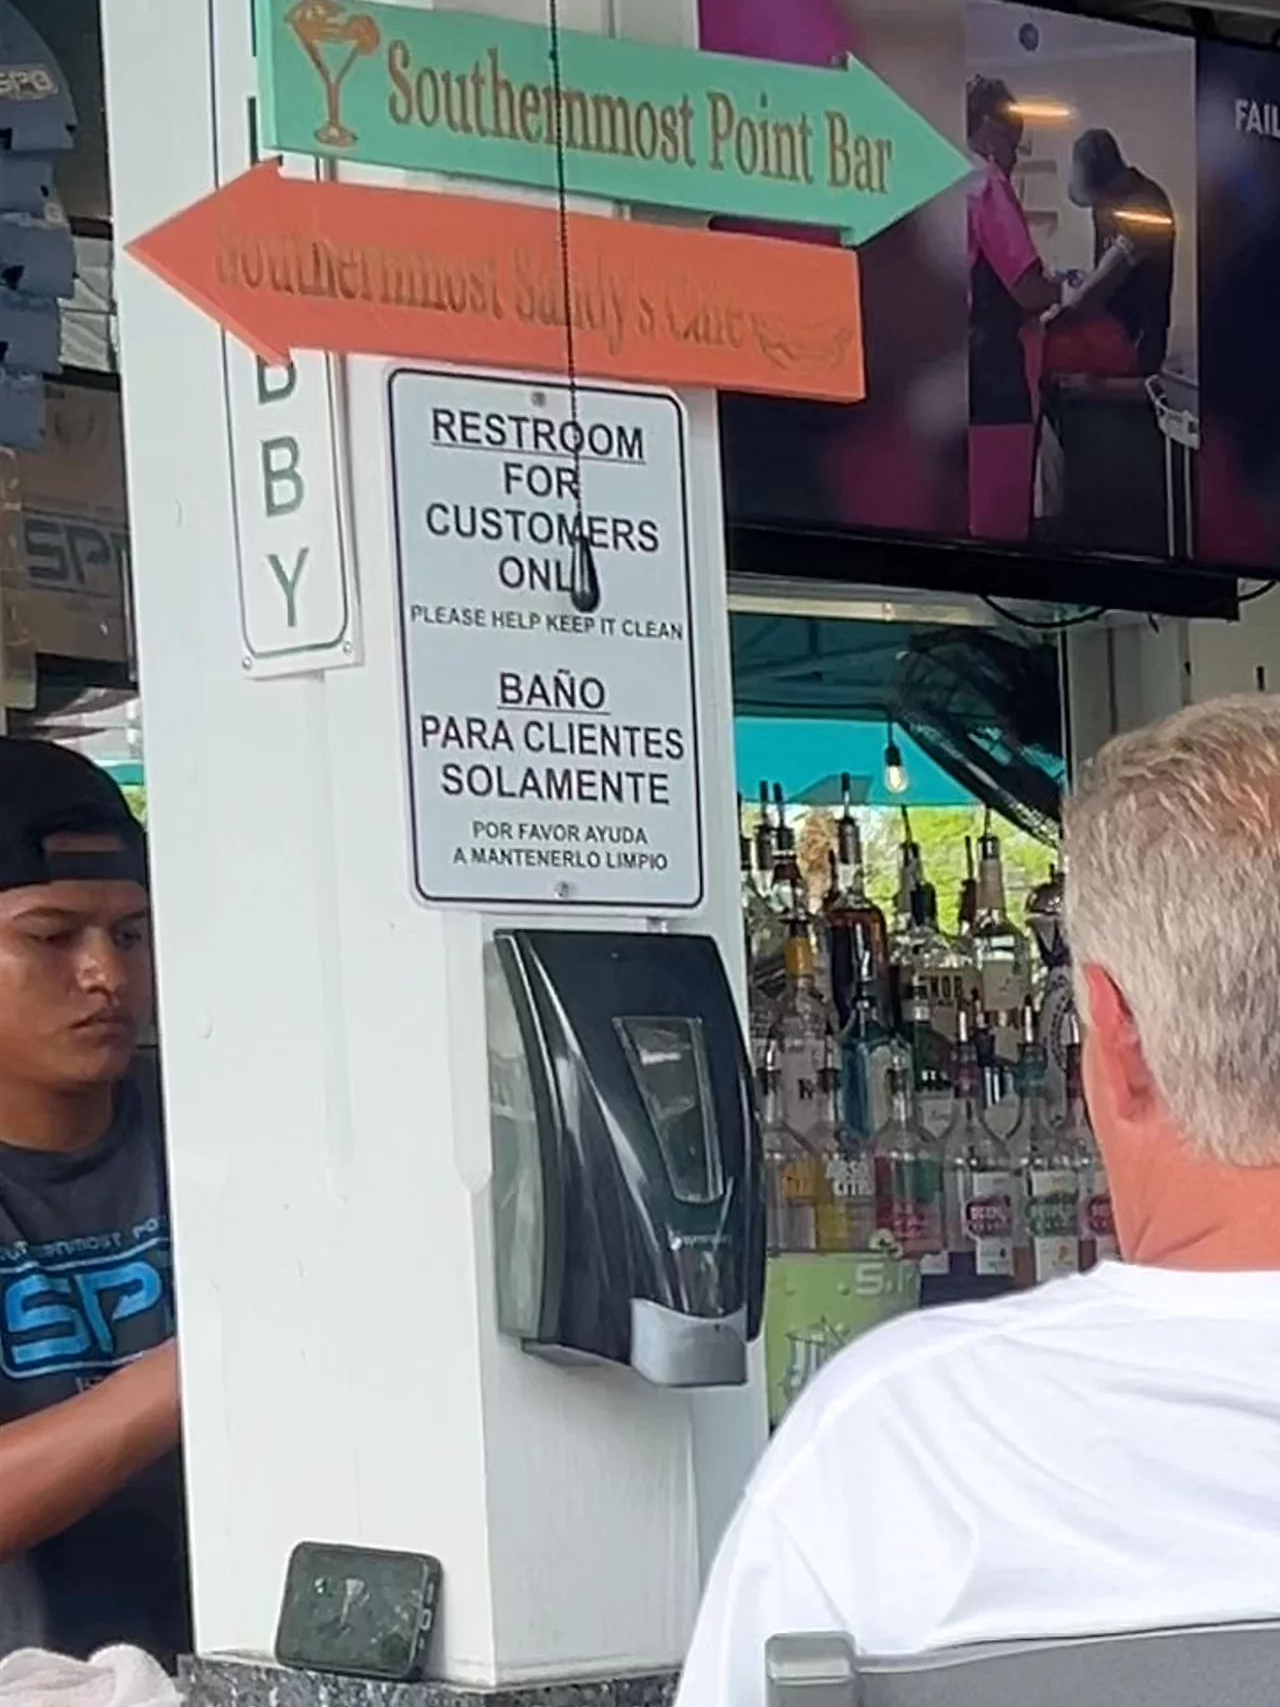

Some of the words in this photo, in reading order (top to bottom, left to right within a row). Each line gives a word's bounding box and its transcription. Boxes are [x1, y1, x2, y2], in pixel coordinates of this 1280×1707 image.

[386, 39, 697, 168] Southernmost
[707, 89, 815, 186] Point
[825, 109, 894, 195] Bar
[215, 198, 504, 319] Southernmost
[513, 247, 656, 355] Sandy's
[431, 407, 645, 460] RESTROOM
[503, 461, 580, 500] FOR
[426, 502, 660, 553] CUSTOMERS
[499, 555, 598, 596] ONL
[410, 604, 486, 628] PLEASE
[491, 609, 541, 632] HELP
[547, 612, 595, 635] KEEP
[601, 616, 616, 636] IT
[621, 618, 683, 641] CLEAN
[499, 668, 606, 710] BAÑO
[420, 714, 515, 753] PARA
[523, 719, 685, 761] CLIENTES
[441, 762, 671, 806] SOLAMENTE
[472, 820, 513, 840] POR
[518, 823, 580, 843] FAVOR
[584, 825, 649, 845] AYUDA
[453, 847, 468, 866] A
[470, 848, 600, 869] MANTENERLO
[606, 852, 669, 871] LIMPIO
